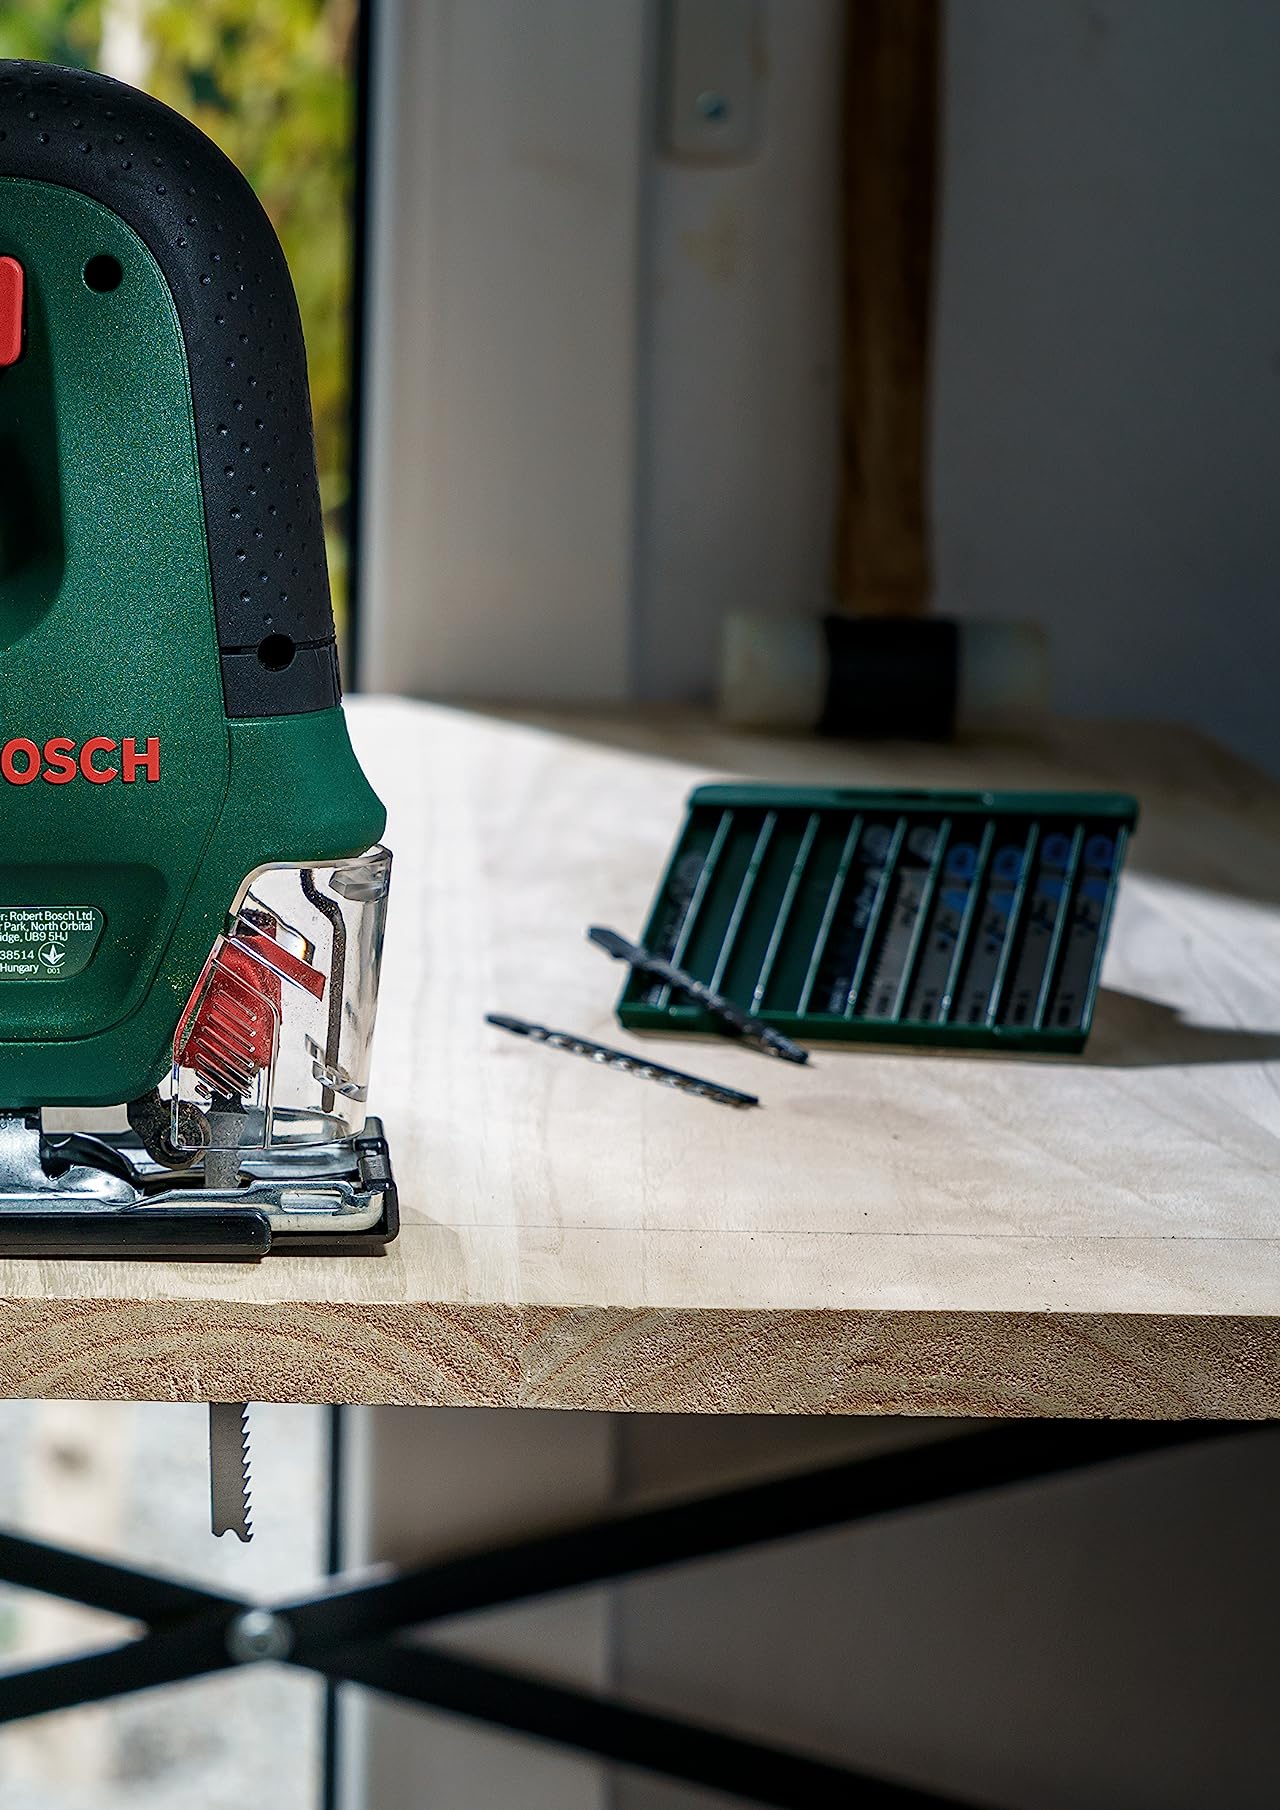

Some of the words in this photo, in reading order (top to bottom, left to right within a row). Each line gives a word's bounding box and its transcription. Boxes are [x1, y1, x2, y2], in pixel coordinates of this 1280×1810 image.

[10, 911, 43, 921] Robert
[44, 910, 75, 921] Bosch
[76, 910, 96, 921] Ltd.
[3, 921, 30, 932] Park,
[30, 921, 59, 931] North
[60, 920, 93, 931] Orbital
[24, 931, 47, 942] UB9
[48, 931, 69, 942] 5HJ
[0, 962, 39, 975] Hungary
